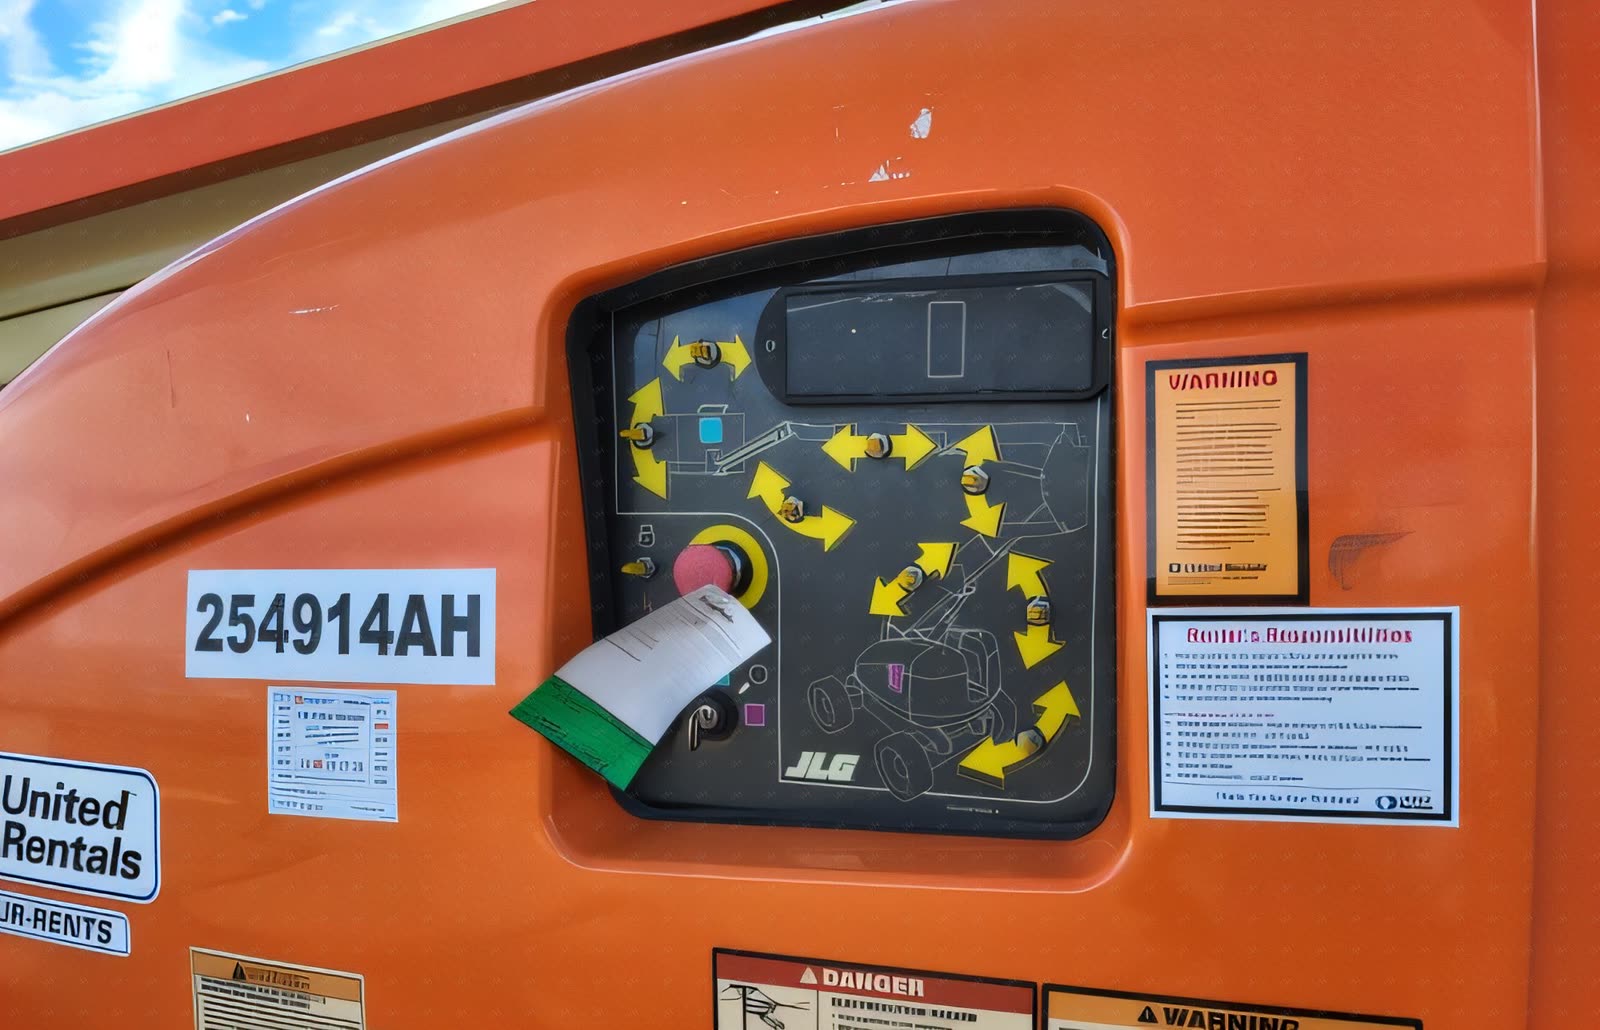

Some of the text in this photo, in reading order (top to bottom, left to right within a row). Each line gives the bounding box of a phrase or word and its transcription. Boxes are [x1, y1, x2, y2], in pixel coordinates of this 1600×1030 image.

[194, 592, 481, 658] 254914AH
[785, 751, 860, 781] JLG
[2, 775, 130, 830] United
[2, 820, 142, 880] Rentals
